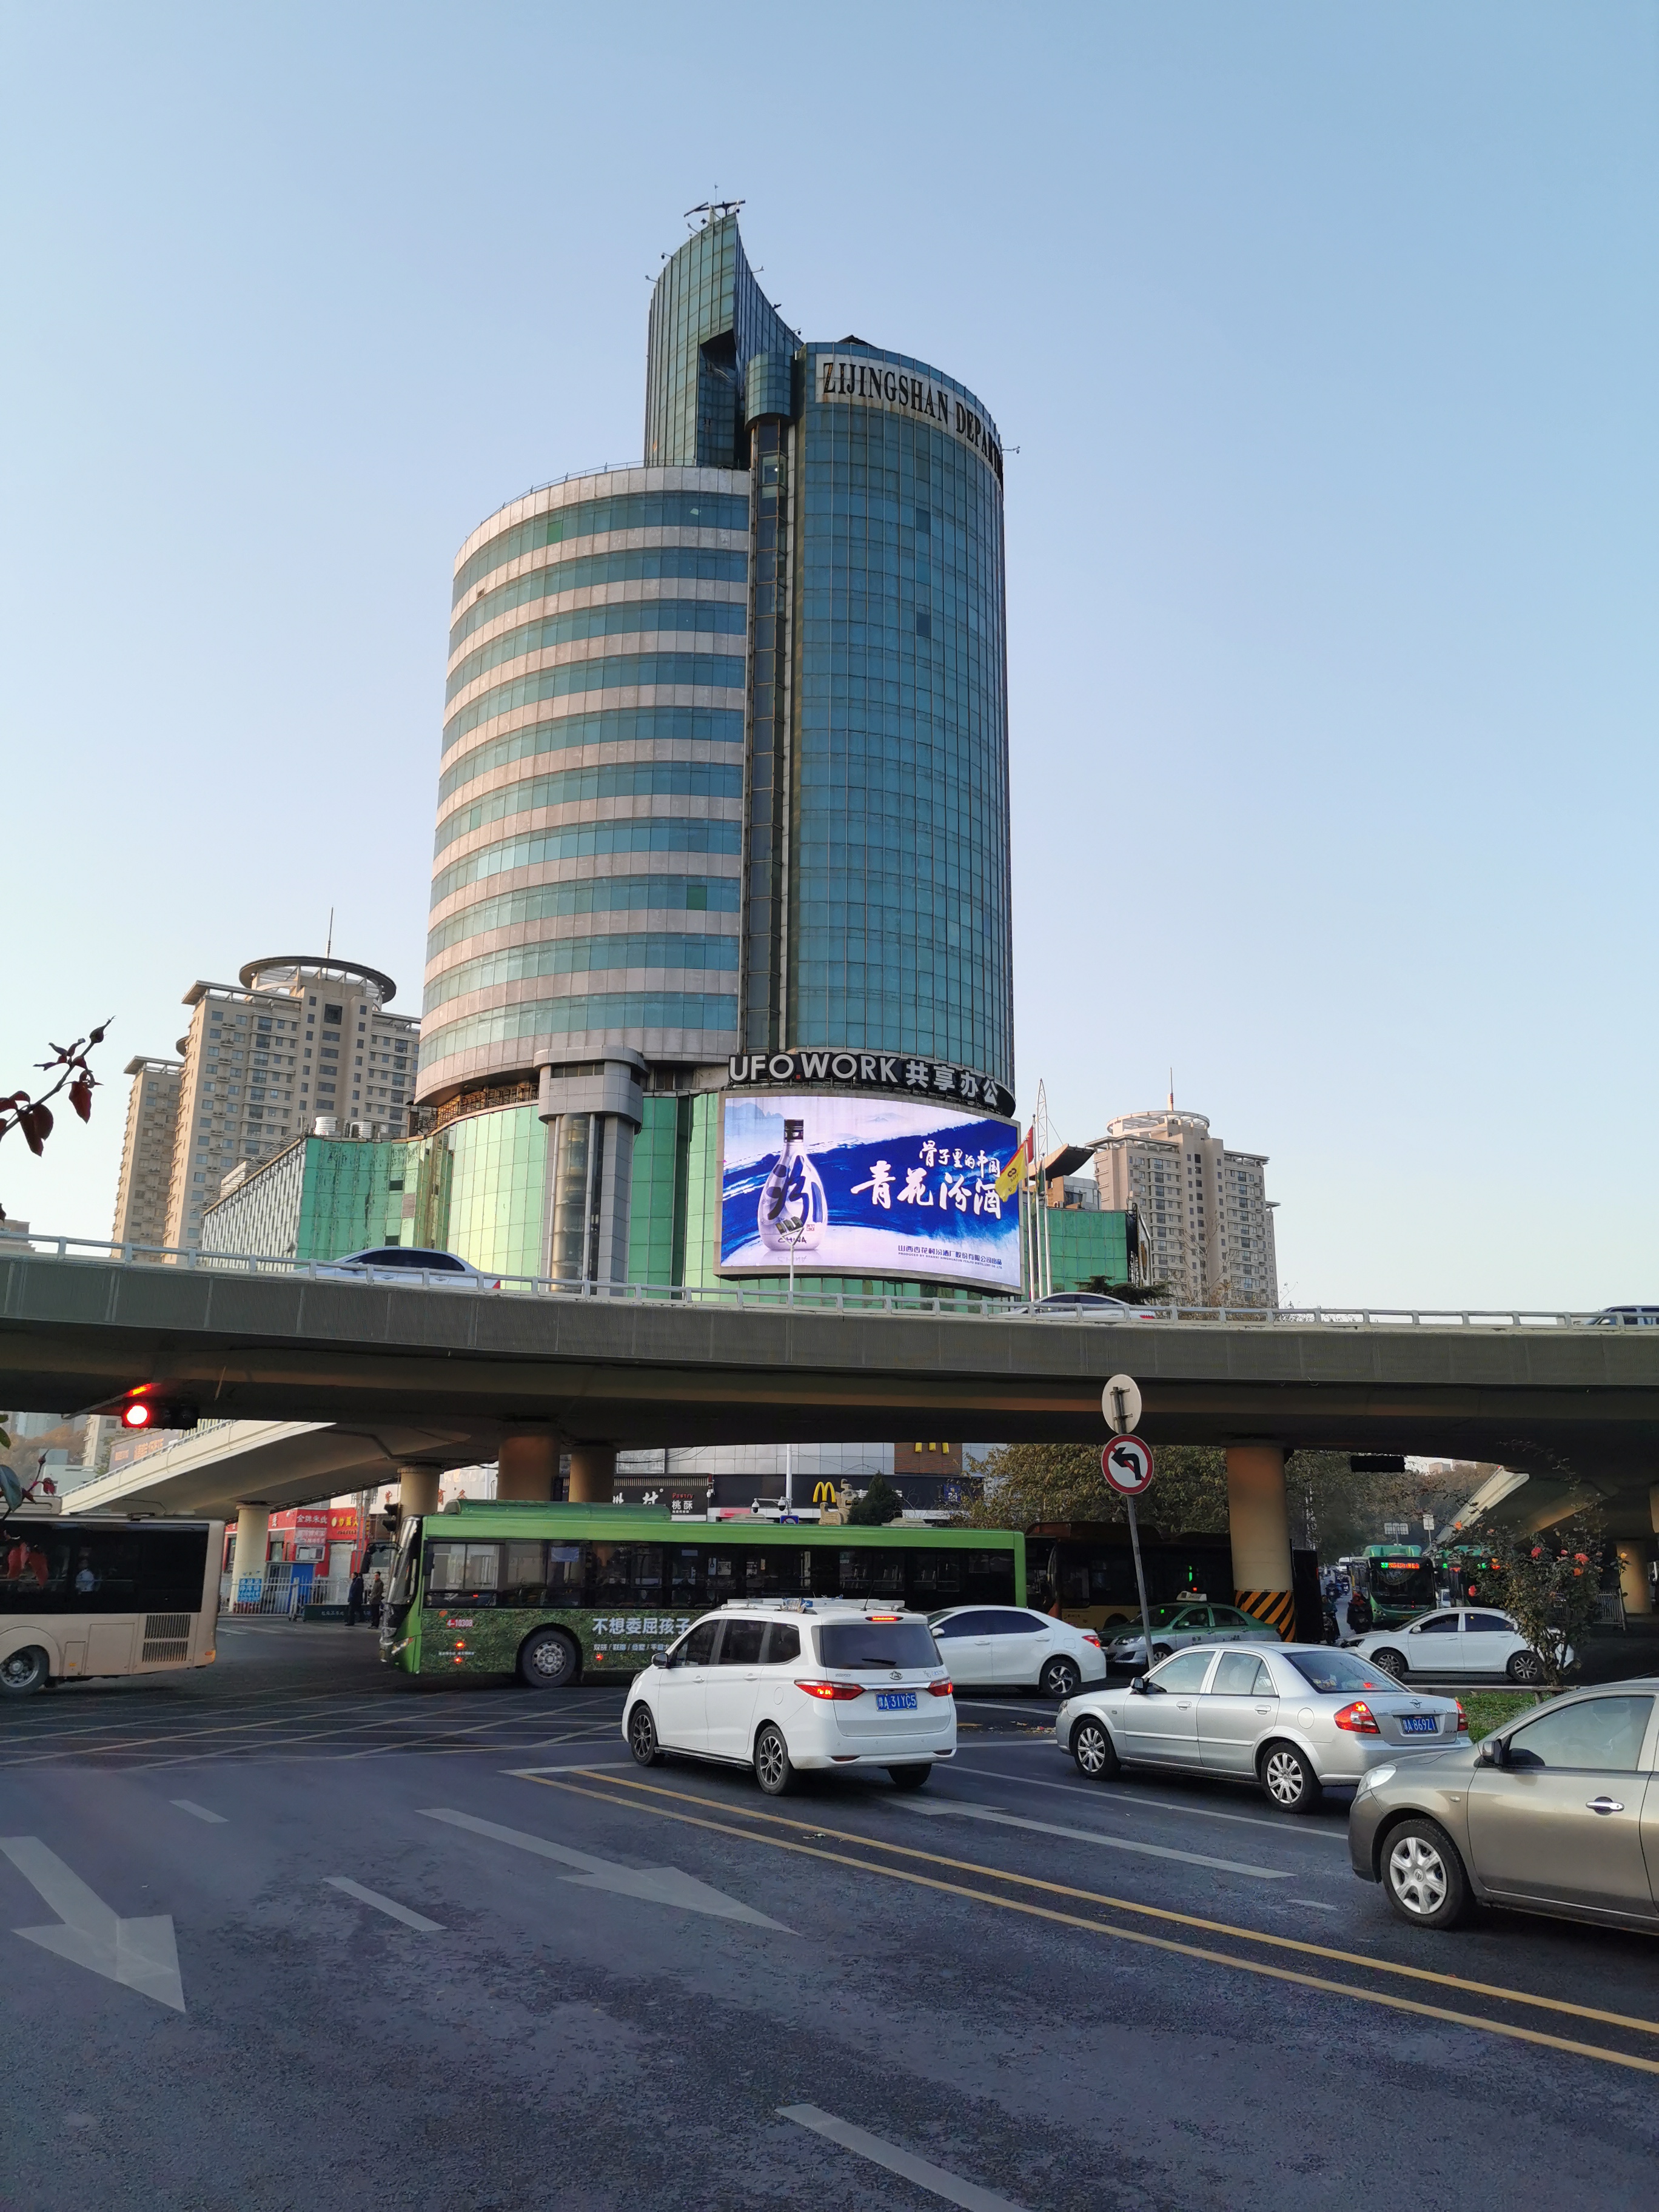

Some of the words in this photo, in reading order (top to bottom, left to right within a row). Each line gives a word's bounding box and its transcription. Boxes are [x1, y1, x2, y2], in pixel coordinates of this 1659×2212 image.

[823, 362, 948, 425] ZIJINGSHAN
[906, 1061, 999, 1107] 共享办公
[851, 1160, 1001, 1220] 青花汾酒
[898, 1245, 1002, 1265] 山西杏花村汾酒厂股份有限公司出品
[671, 1500, 693, 1510] 桃酥
[592, 1618, 691, 1635] 不想委屈孩子
